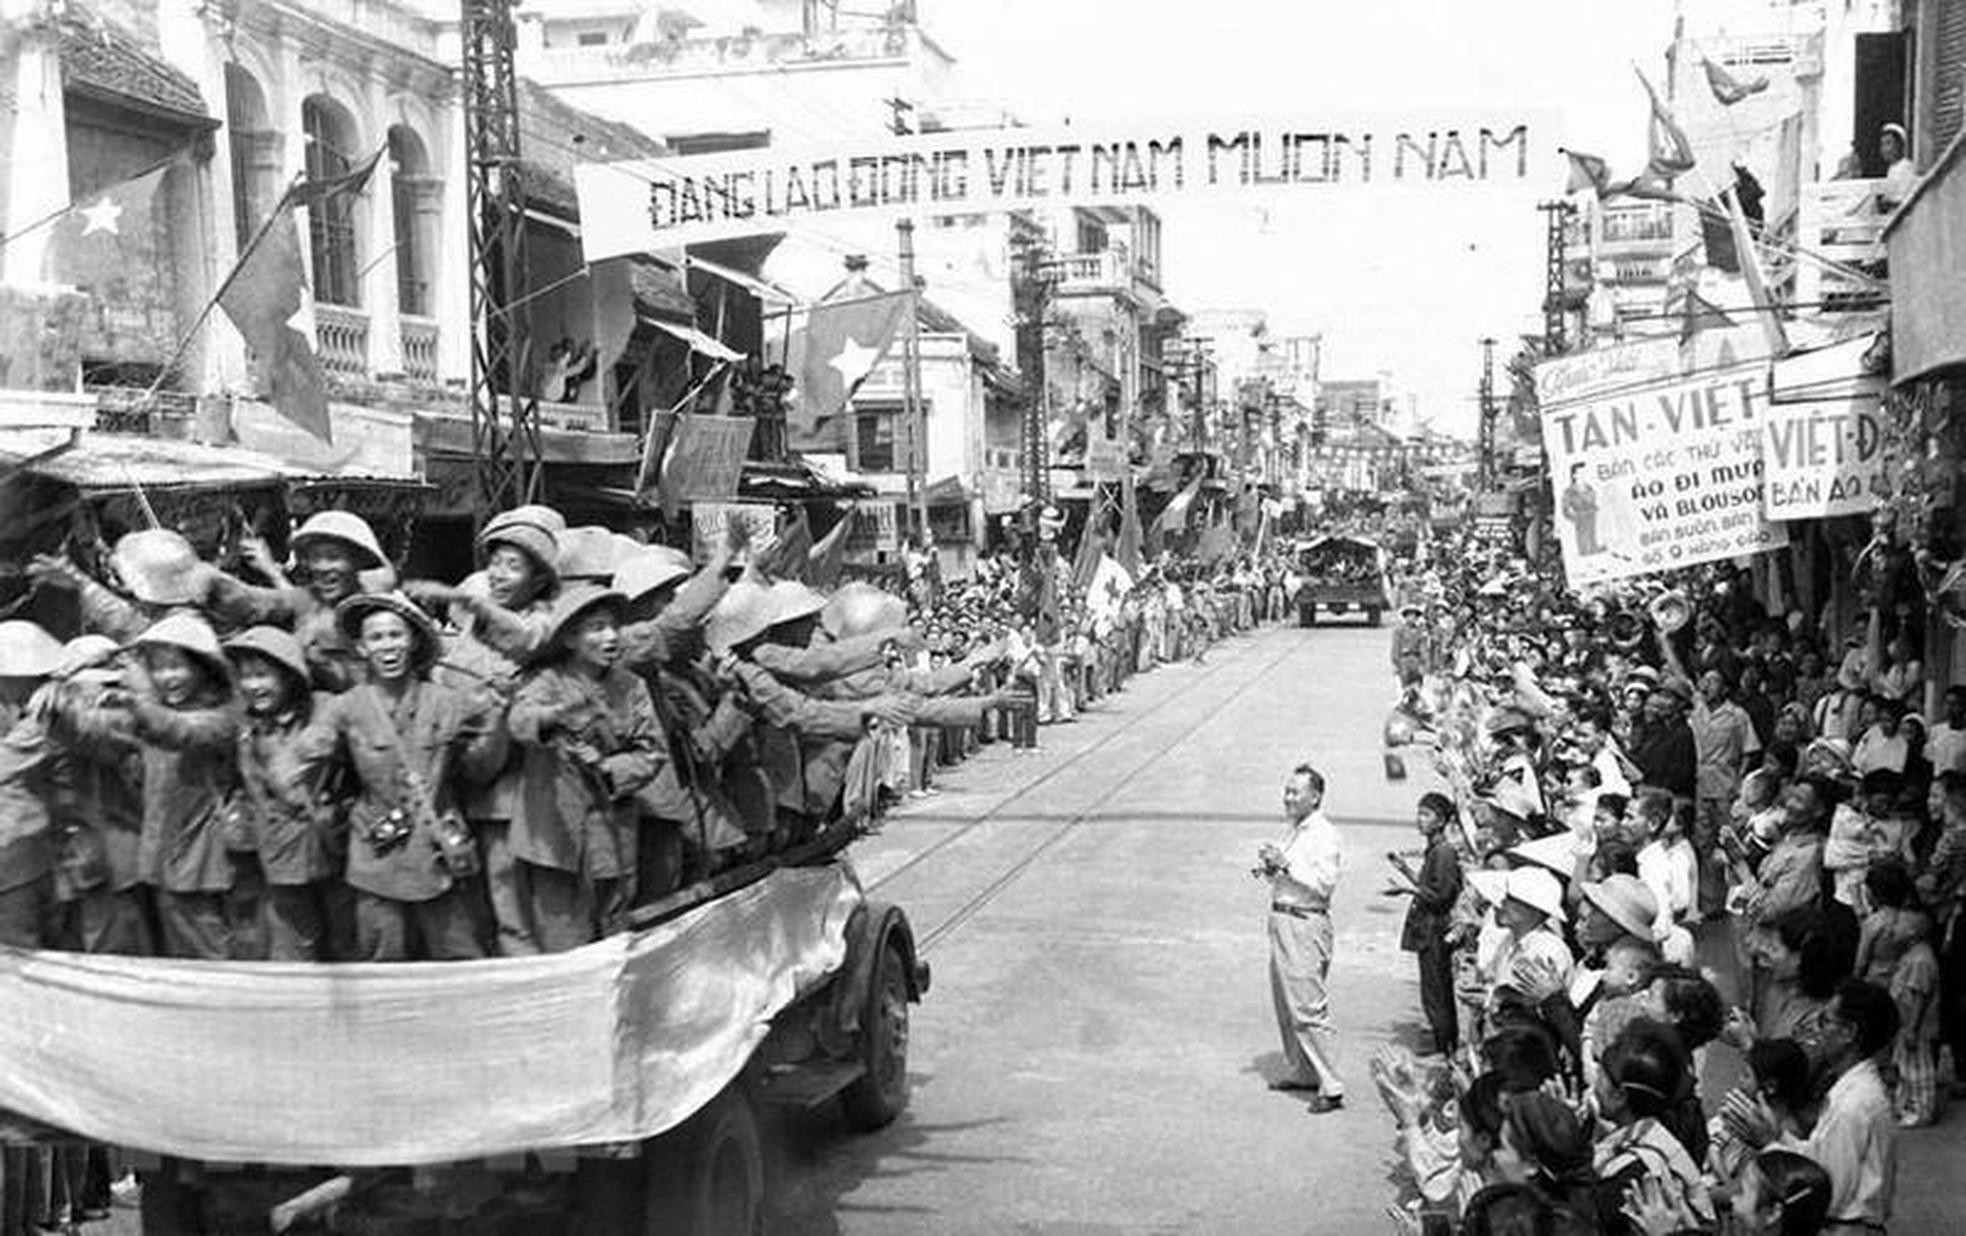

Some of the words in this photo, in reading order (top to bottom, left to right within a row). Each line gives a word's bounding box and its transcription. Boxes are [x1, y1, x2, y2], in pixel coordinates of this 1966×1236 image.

[764, 159, 841, 216] LAO
[985, 145, 1081, 197] VIET
[1091, 135, 1182, 196] NAM
[1395, 124, 1528, 180] NAM
